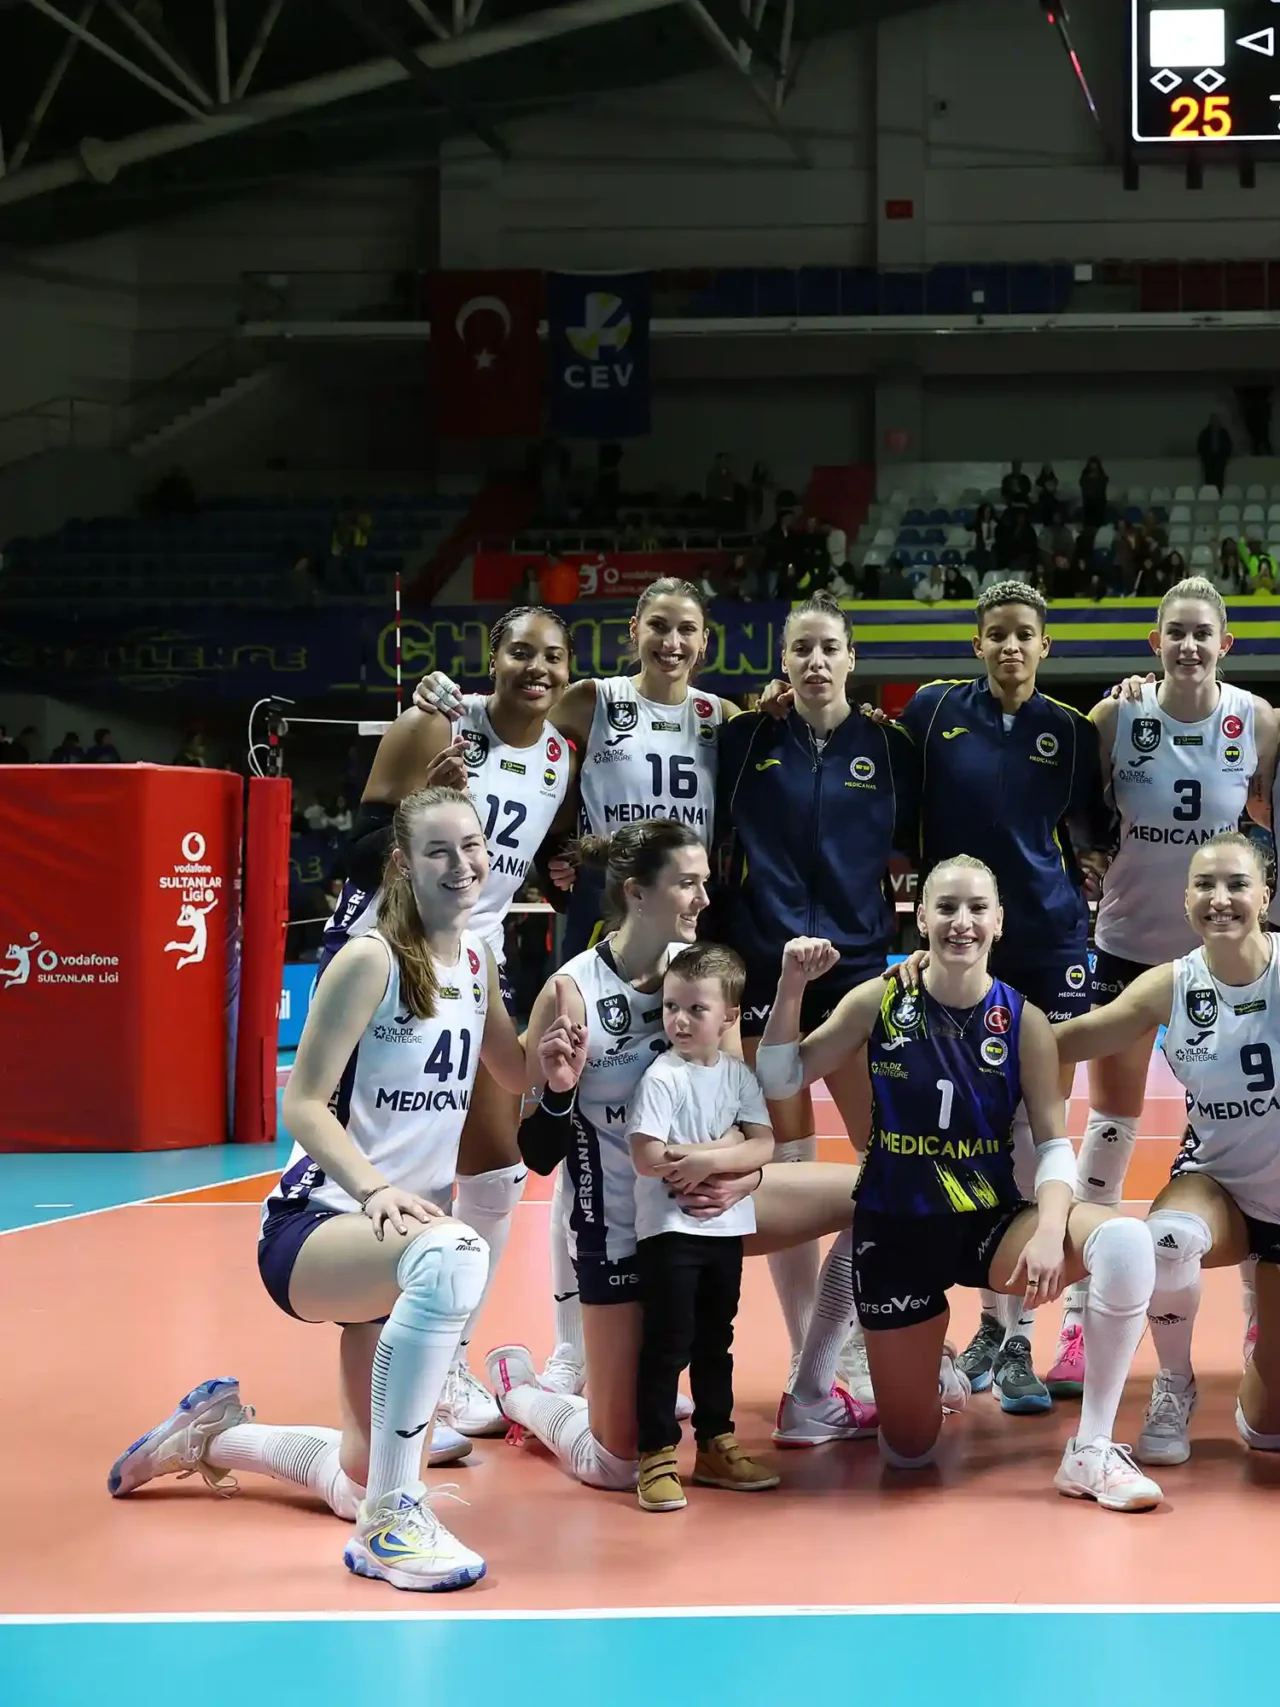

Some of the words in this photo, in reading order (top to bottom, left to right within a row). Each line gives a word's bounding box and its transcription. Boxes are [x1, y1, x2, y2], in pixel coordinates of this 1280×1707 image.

[1170, 96, 1232, 137] 25
[563, 362, 634, 390] CEV
[645, 753, 698, 799] 16
[1173, 779, 1202, 822] 3
[482, 793, 527, 849] 12
[173, 863, 212, 874] vodafone
[159, 876, 222, 889] SULTANLAR
[60, 954, 119, 966] vodafone
[37, 973, 95, 984] SULTANLAR
[386, 1027, 414, 1037] YILDIZ
[423, 1027, 471, 1083] 41
[1184, 1047, 1209, 1056] YILDIZ
[1239, 1042, 1275, 1092] 9
[936, 1078, 955, 1130] 1
[1156, 1240, 1179, 1250] adidas
[859, 1294, 931, 1314] arsaVev
